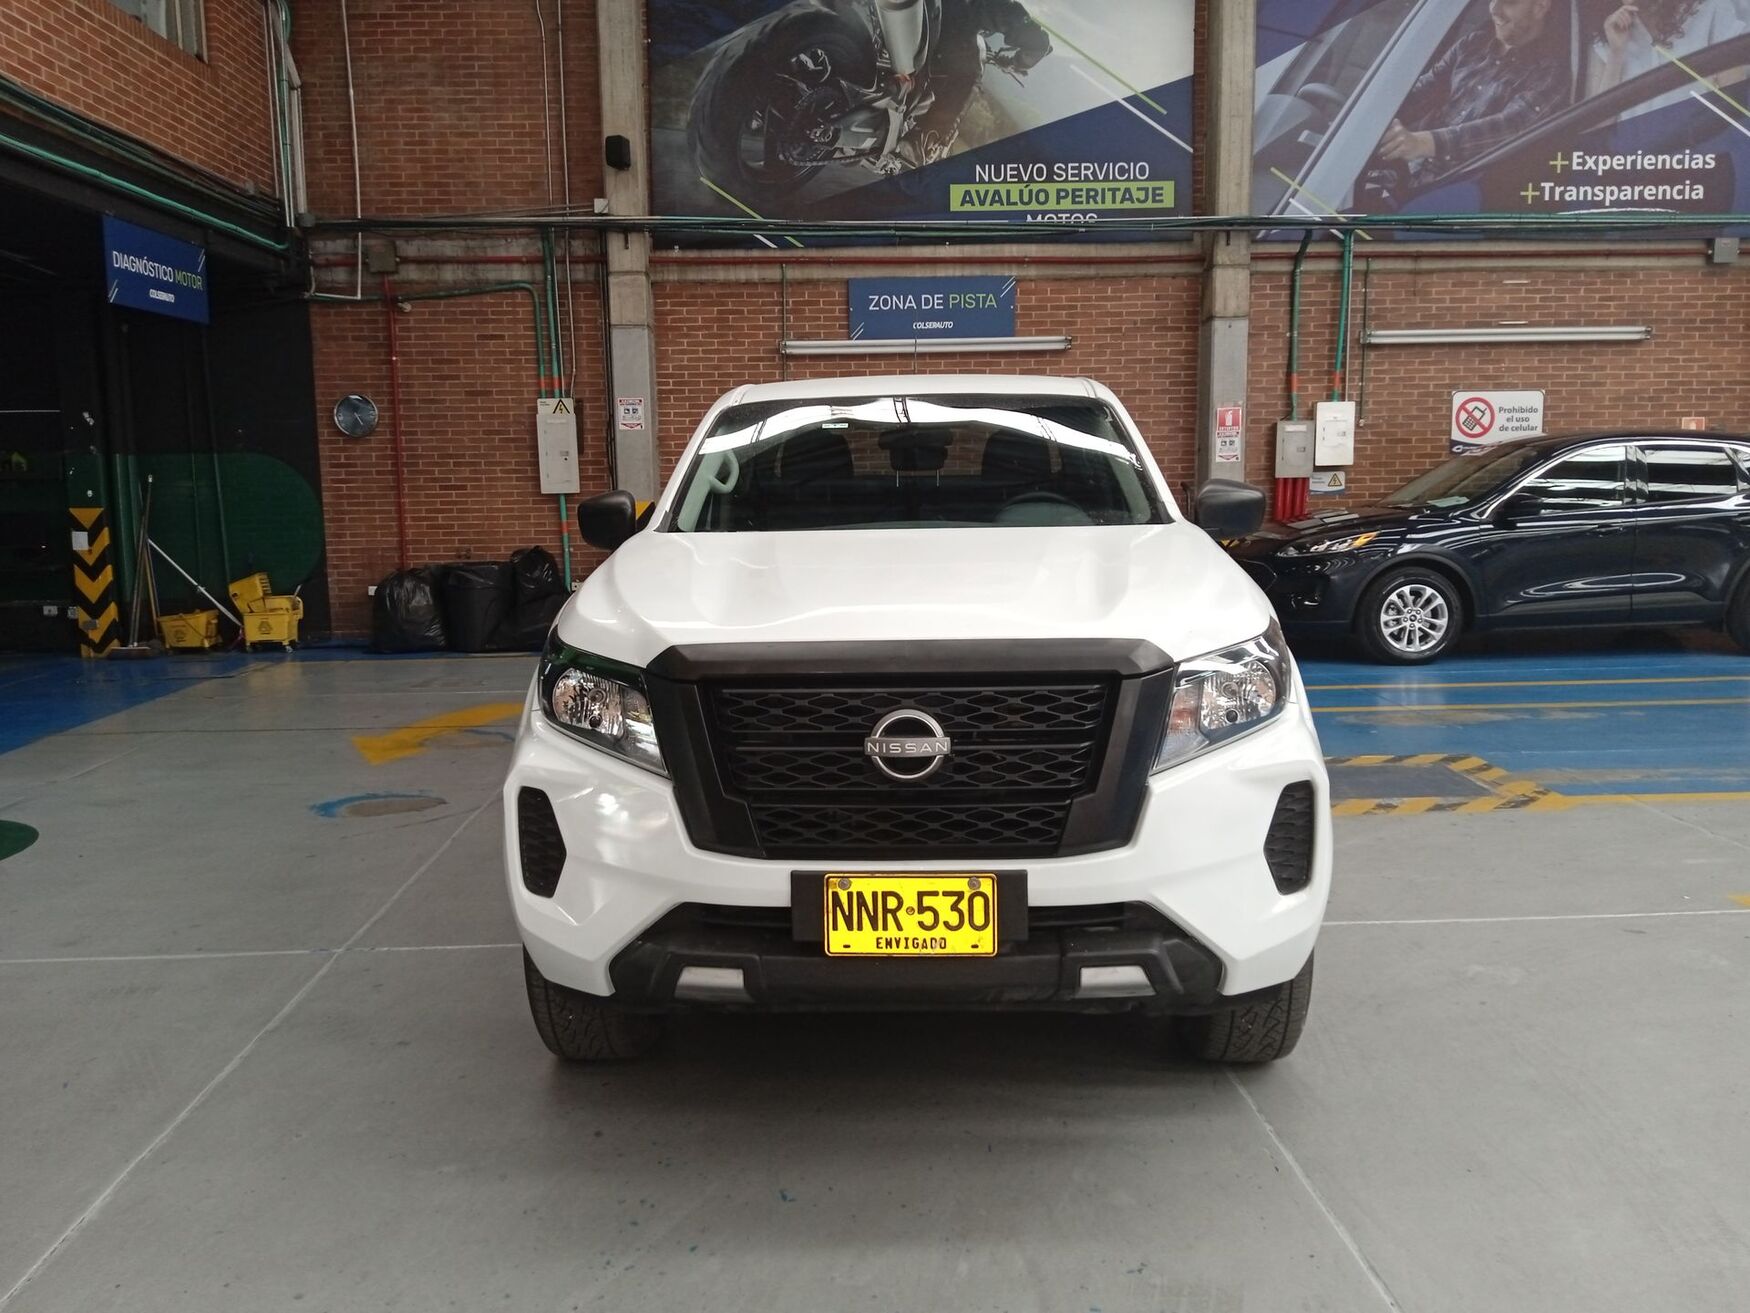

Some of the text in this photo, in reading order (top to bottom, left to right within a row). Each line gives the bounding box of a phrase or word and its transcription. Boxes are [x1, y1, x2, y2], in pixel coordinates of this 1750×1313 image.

[975, 162, 1150, 183] NUEVO SERVICIO
[960, 184, 1164, 207] AVALÚO PERITAJE
[112, 250, 204, 290] DIAGNÓSTICO MOTOR
[868, 293, 998, 311] ZONA DE PISTA
[1498, 406, 1539, 414] Prohibido
[1506, 415, 1514, 423] el
[1499, 424, 1538, 432] de celular
[867, 742, 948, 754] NISSAN
[876, 937, 947, 950] ENVIGADO
